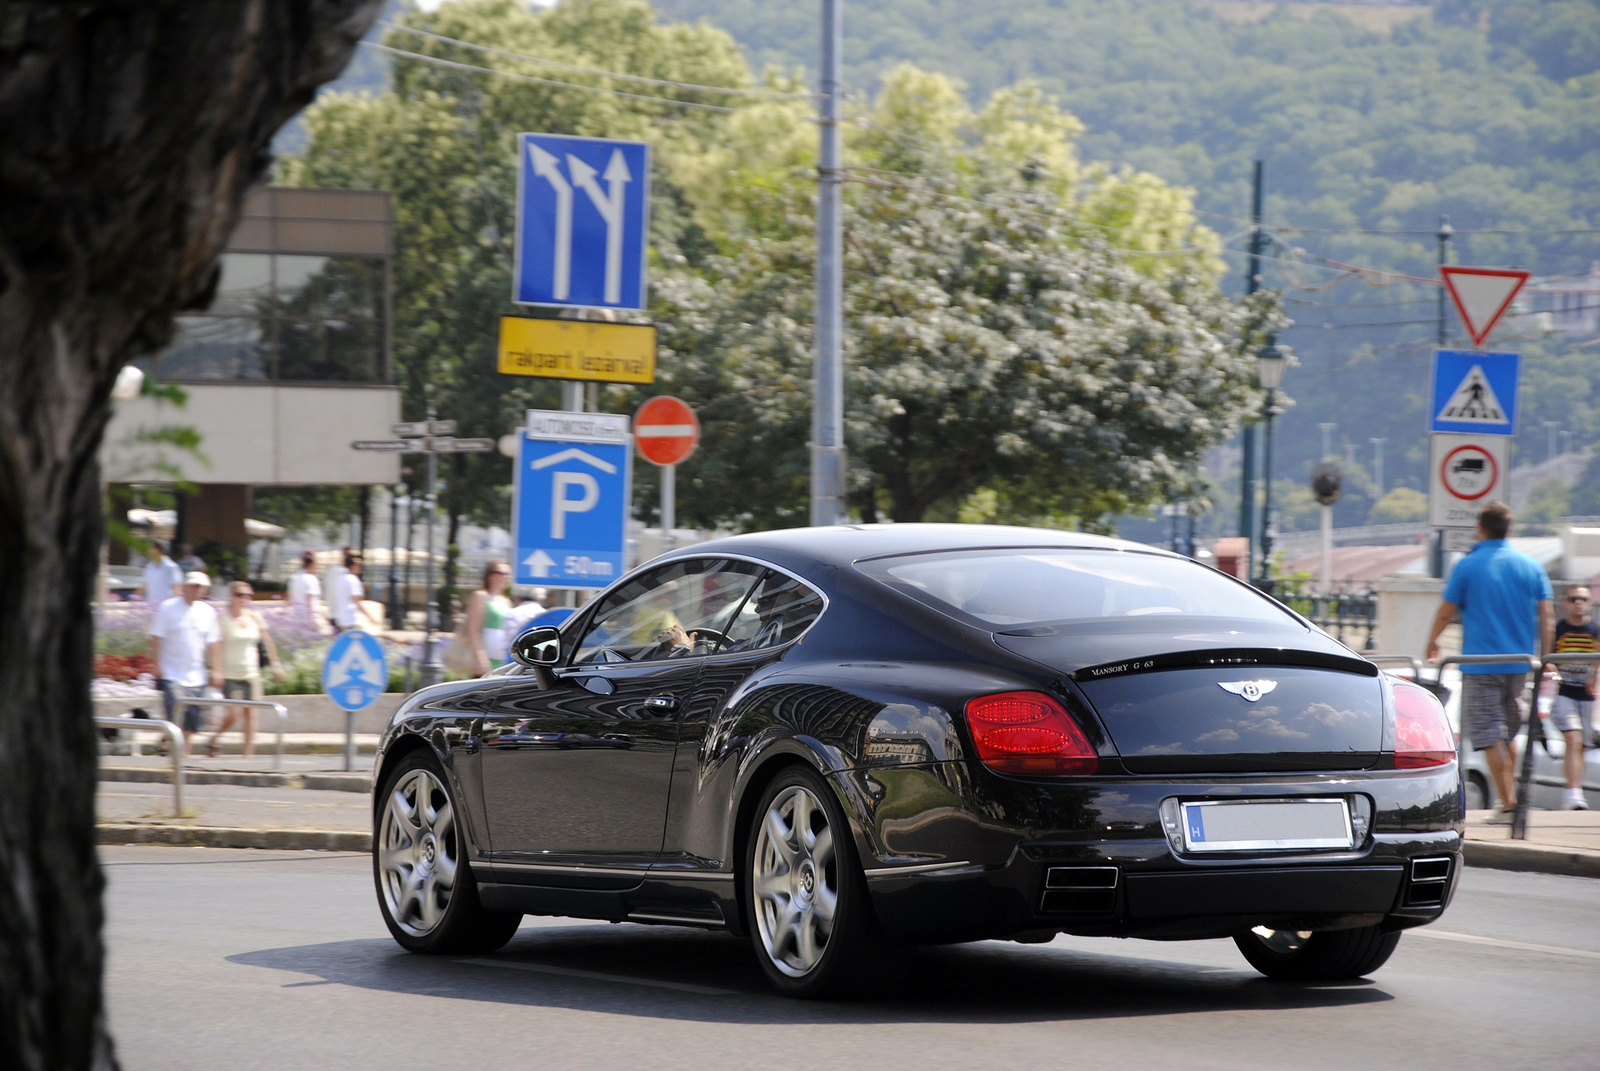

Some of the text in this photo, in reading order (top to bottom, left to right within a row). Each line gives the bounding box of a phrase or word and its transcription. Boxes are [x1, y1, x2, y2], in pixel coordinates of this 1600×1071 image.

[506, 348, 572, 373] rakpart
[550, 471, 600, 539] P
[1091, 663, 1128, 676] MANSORY
[1144, 660, 1154, 668] 63
[1191, 826, 1201, 838] H
